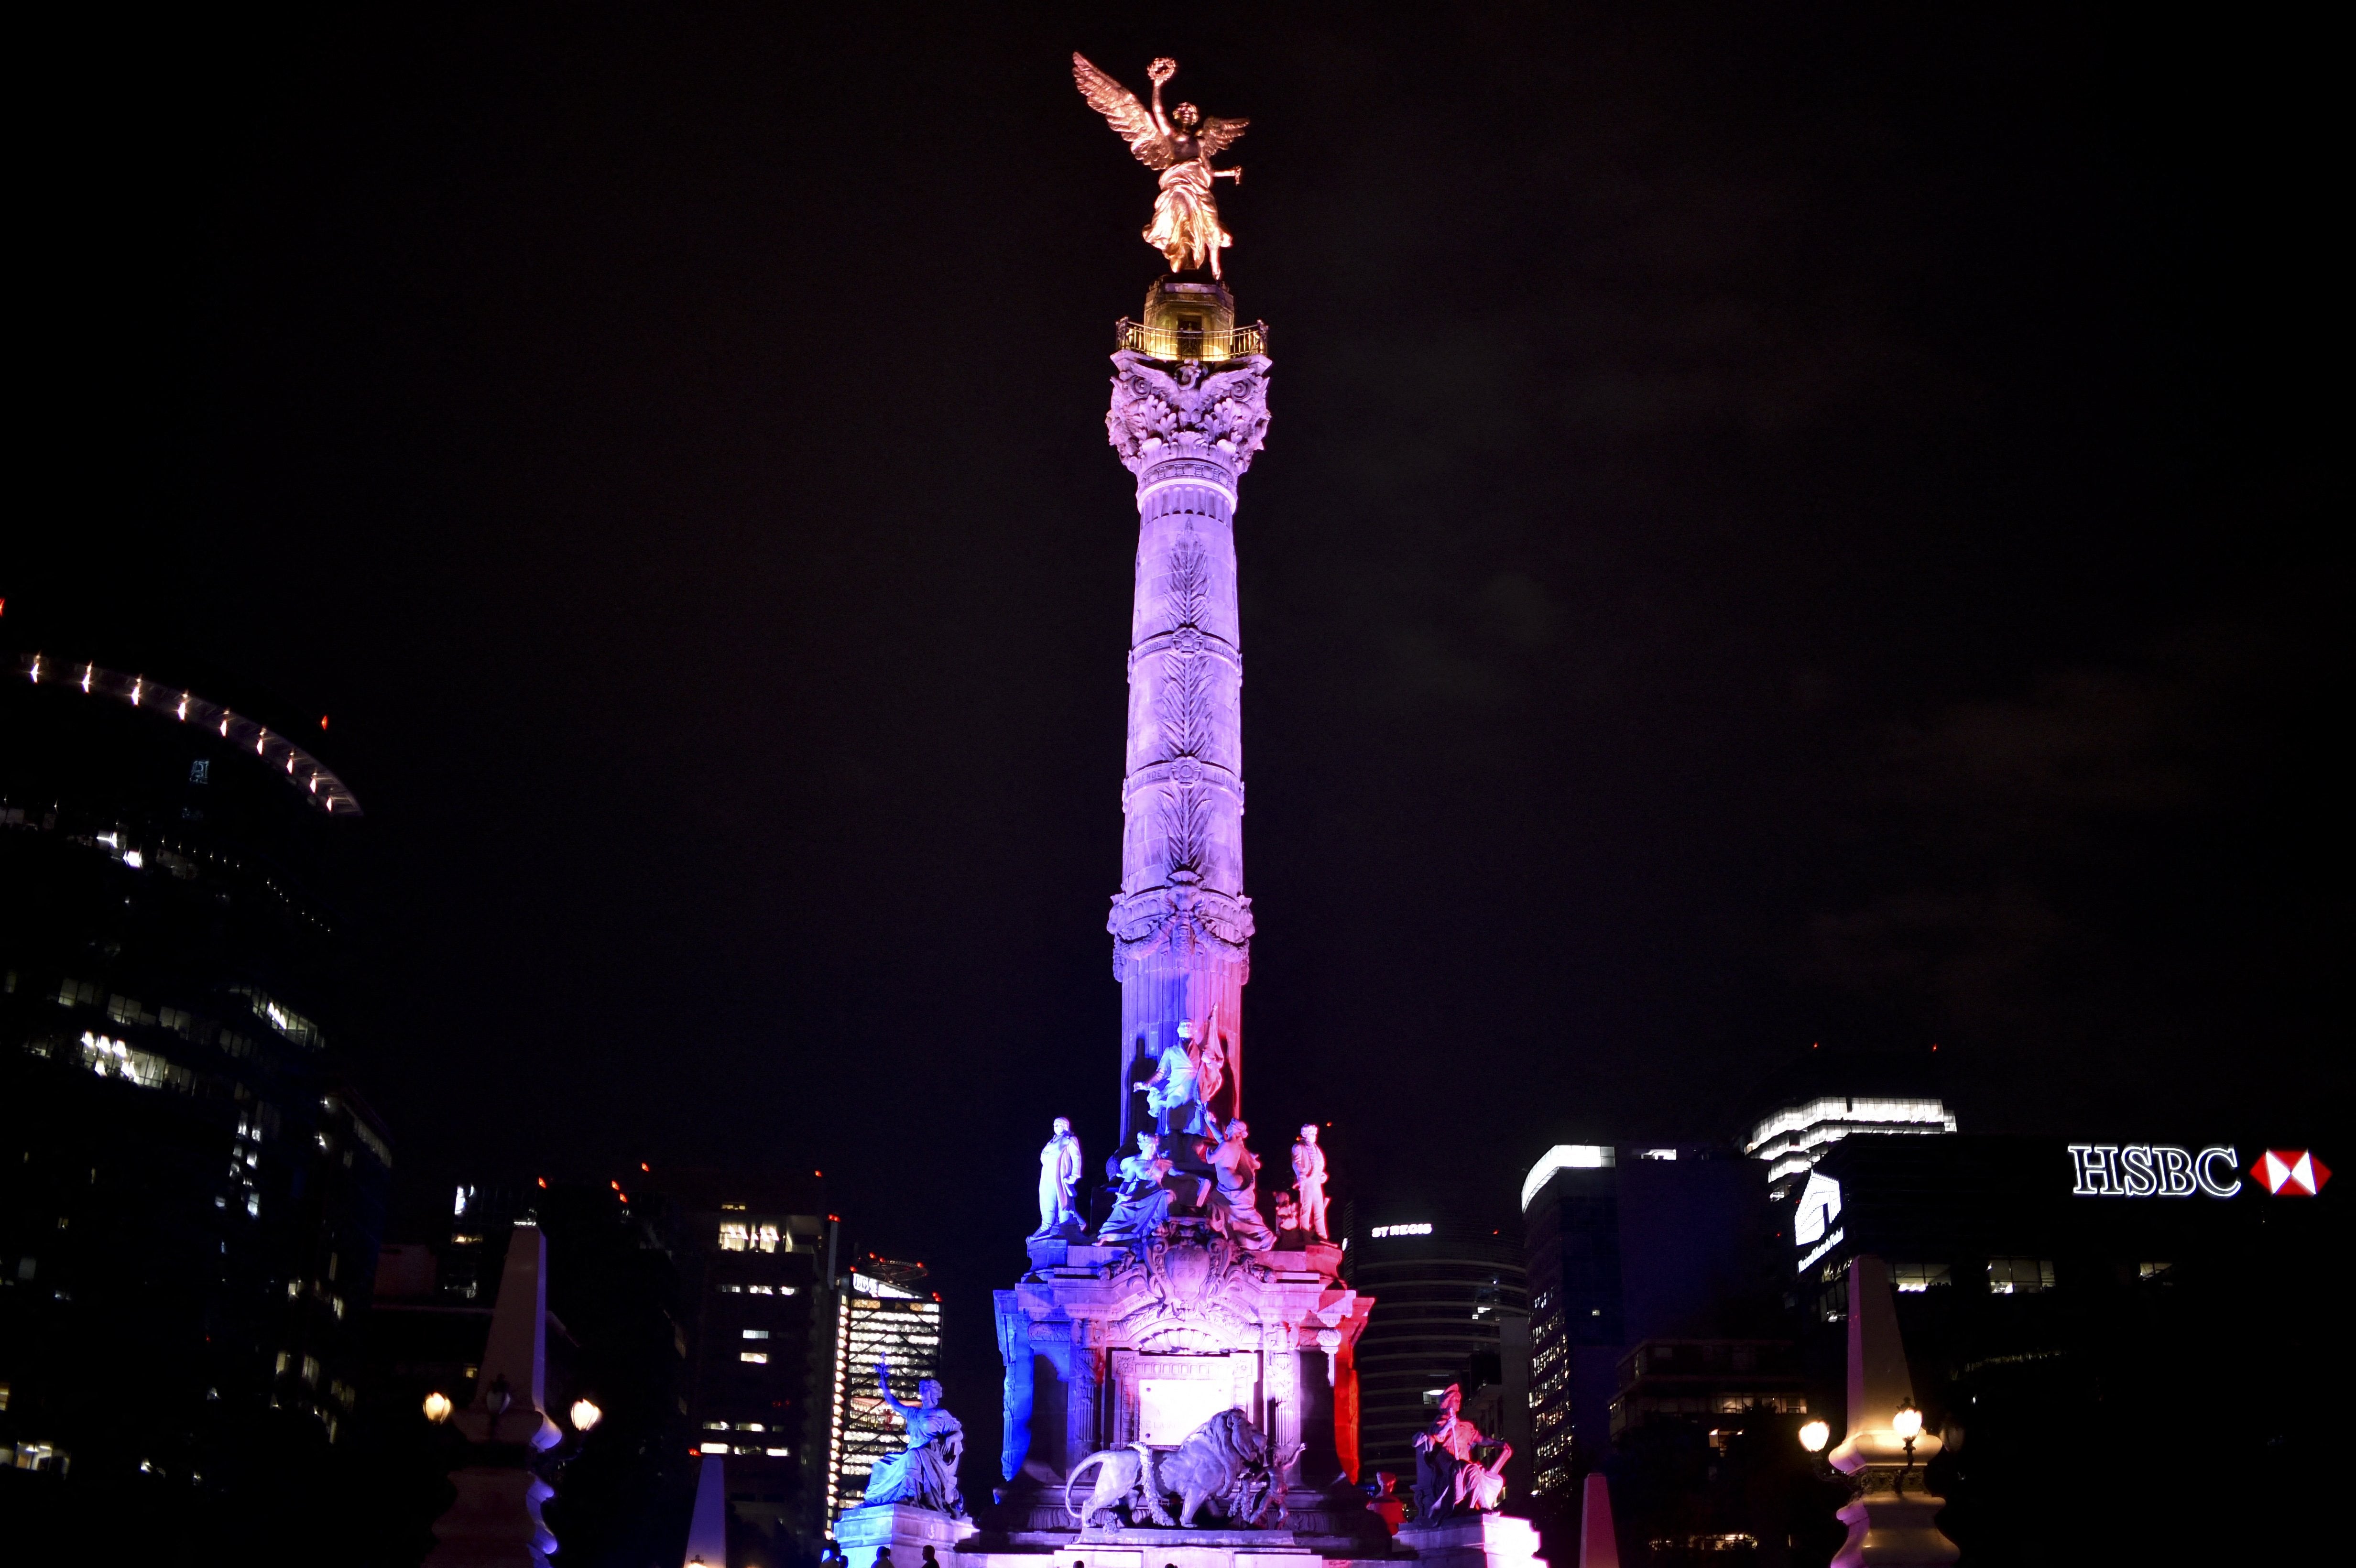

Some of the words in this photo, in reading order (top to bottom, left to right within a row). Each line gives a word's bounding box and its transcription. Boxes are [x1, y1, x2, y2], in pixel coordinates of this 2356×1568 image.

[2068, 1144, 2241, 1197] HSBC
[1372, 1226, 1389, 1238] ST
[1390, 1223, 1432, 1236] REGIS
